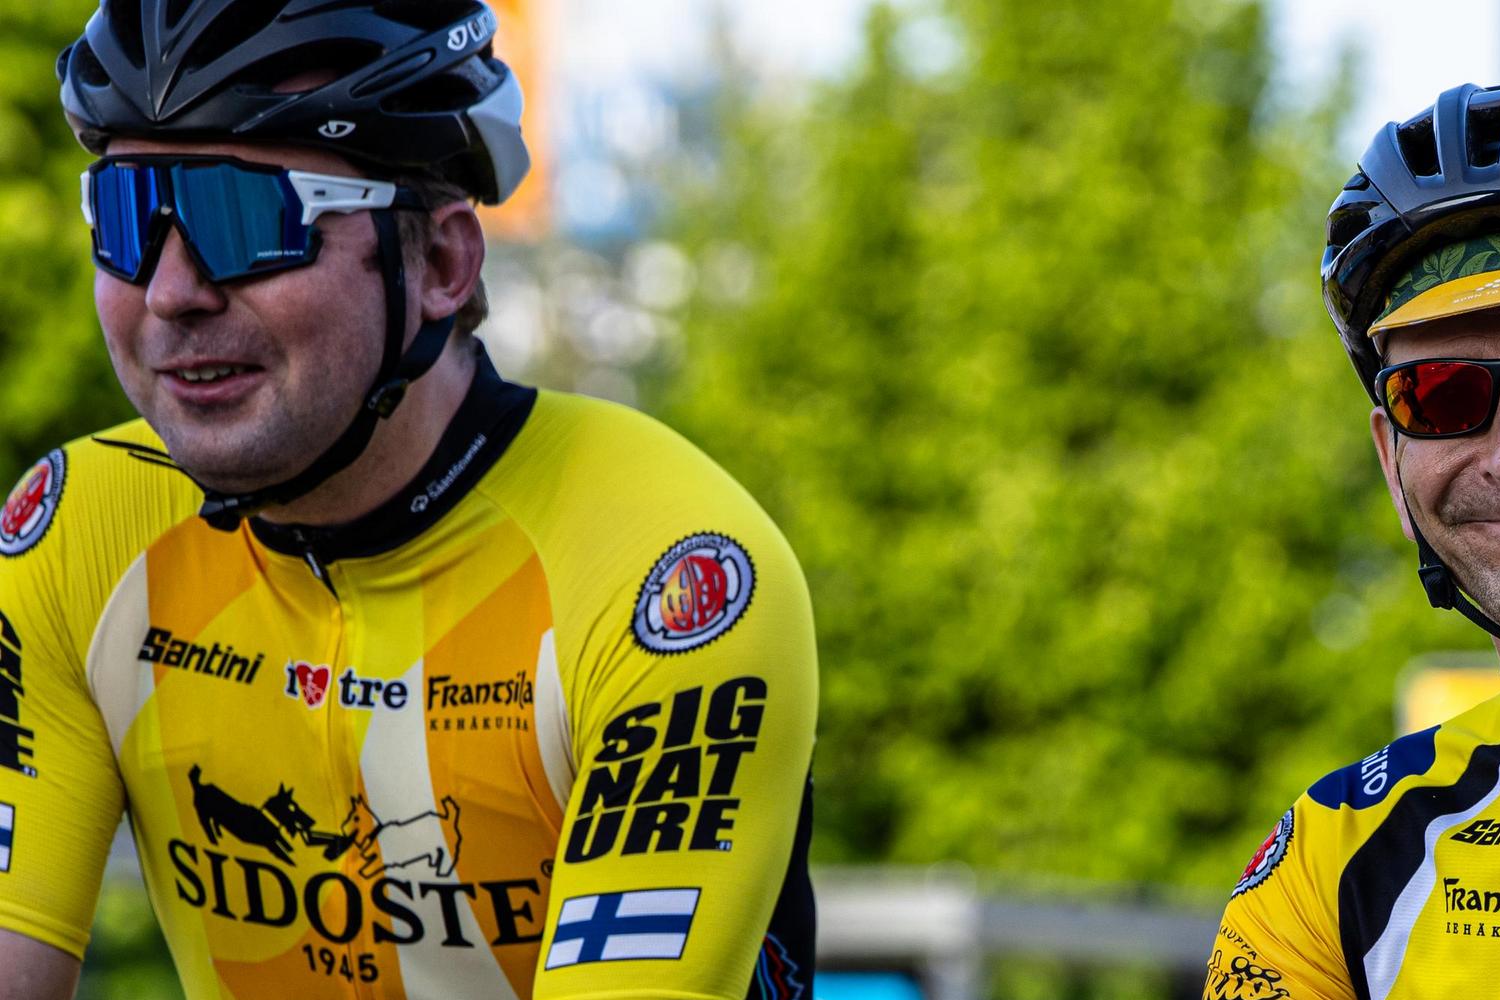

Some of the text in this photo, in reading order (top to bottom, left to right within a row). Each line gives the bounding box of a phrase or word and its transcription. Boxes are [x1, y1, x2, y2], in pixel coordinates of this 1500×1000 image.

[137, 626, 265, 685] Santini
[340, 668, 408, 709] tre
[427, 670, 533, 711] Frantsila
[594, 676, 768, 762] SIG
[578, 741, 757, 817] NAT
[564, 798, 741, 864] URE
[167, 838, 544, 949] SIDOSTE
[303, 944, 379, 984] 1945
